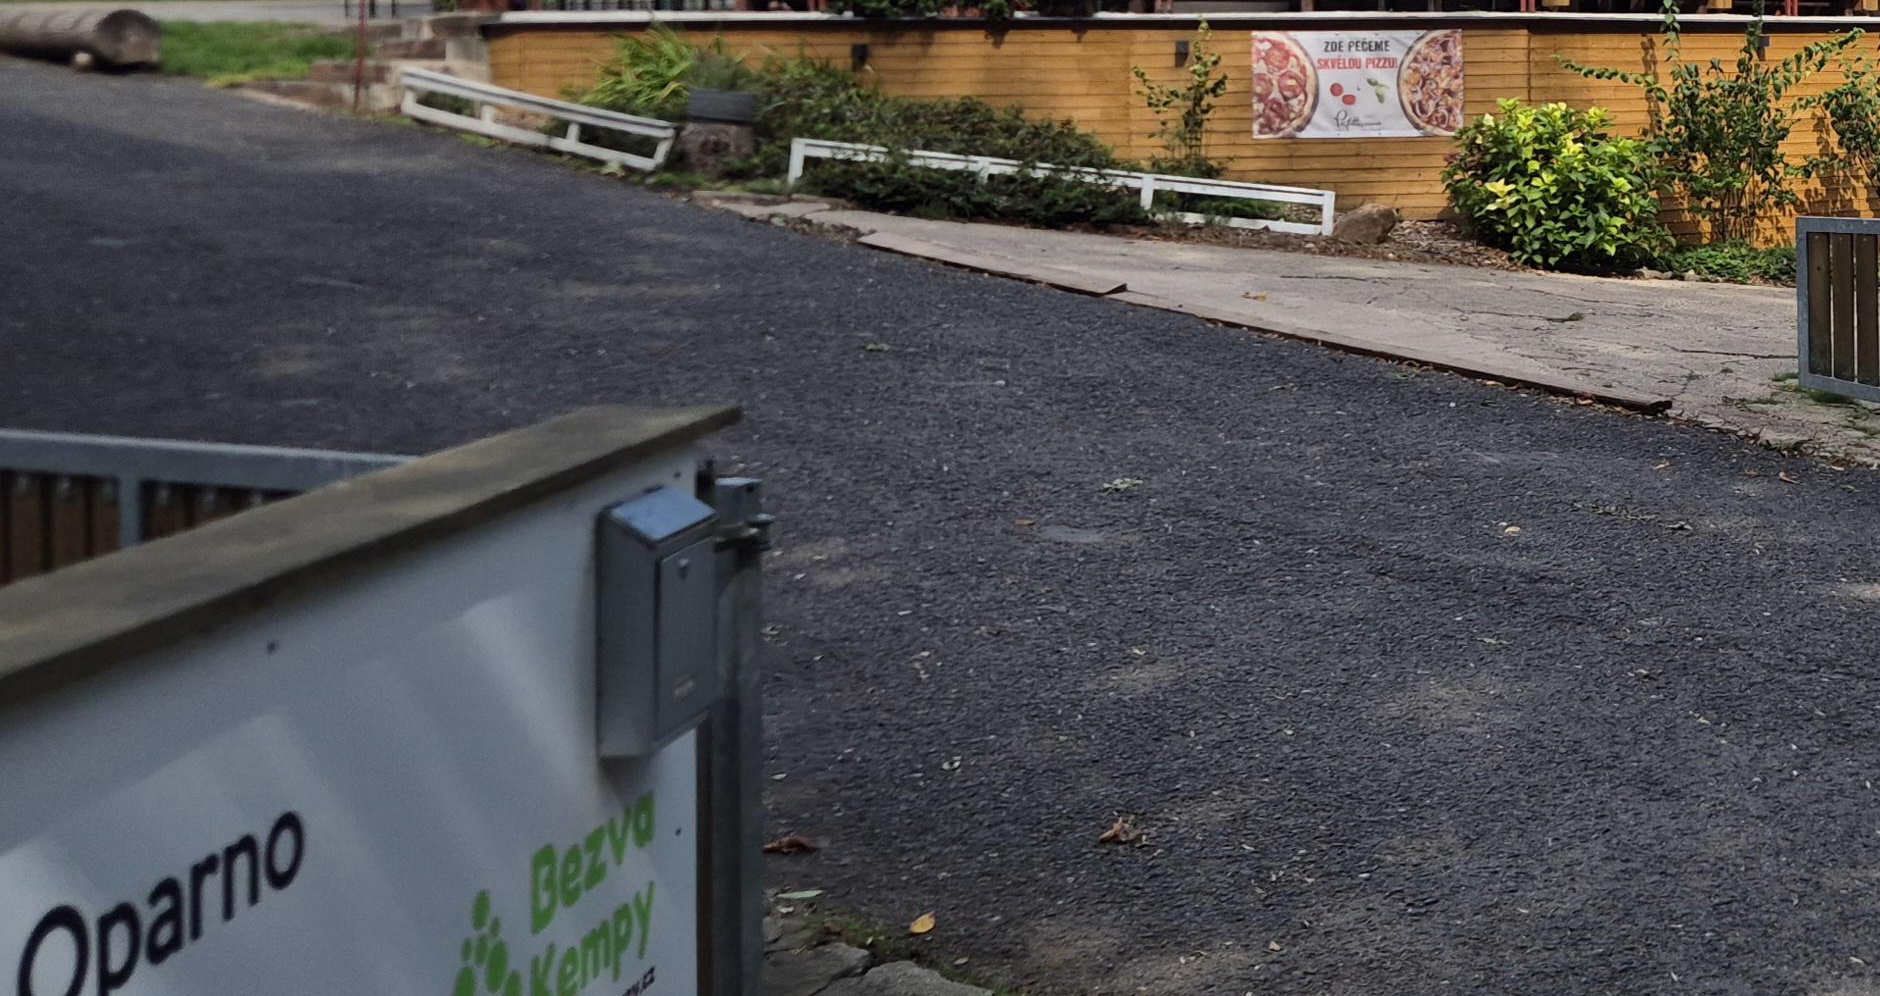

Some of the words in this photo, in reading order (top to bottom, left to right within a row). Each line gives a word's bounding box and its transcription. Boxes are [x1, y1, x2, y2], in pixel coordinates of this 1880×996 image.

[1324, 41, 1344, 53] ZDE
[1348, 38, 1390, 52] PEČEME
[18, 810, 304, 996] Oparno
[530, 790, 656, 936] Bezva
[530, 881, 656, 996] Kempy
